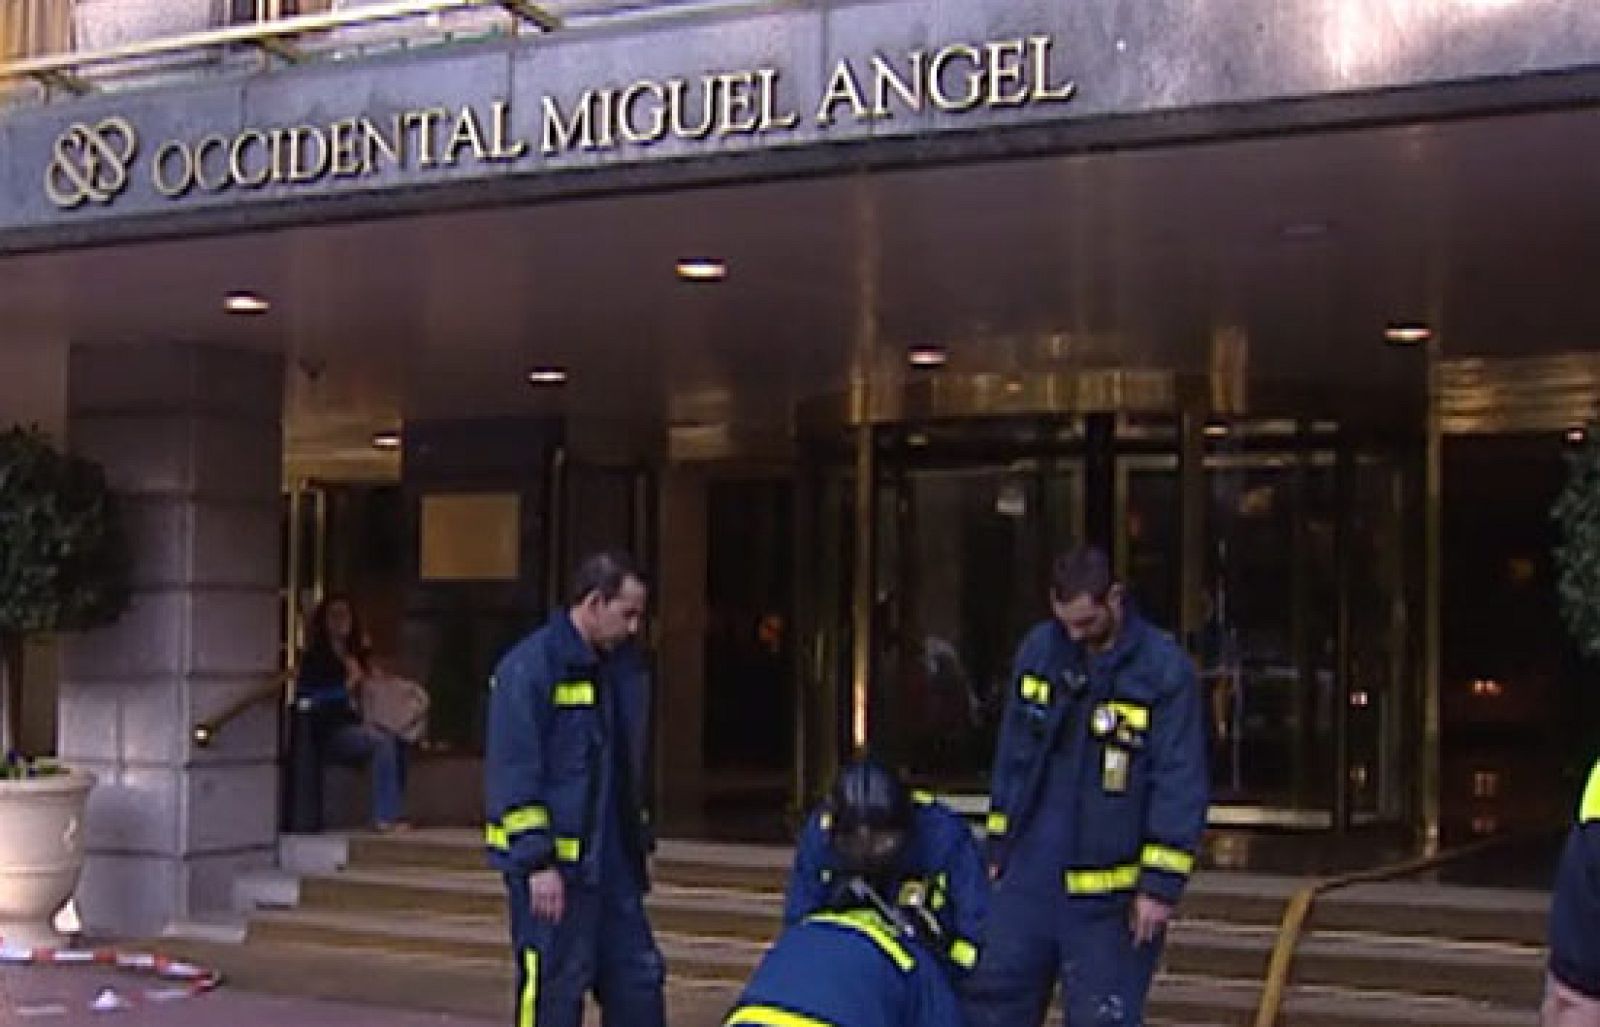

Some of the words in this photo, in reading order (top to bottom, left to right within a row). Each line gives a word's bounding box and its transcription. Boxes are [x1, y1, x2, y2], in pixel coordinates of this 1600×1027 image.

[153, 100, 525, 197] OCCIDENTAL
[541, 68, 798, 154] MIGUEL
[816, 35, 1075, 126] ANGEL
